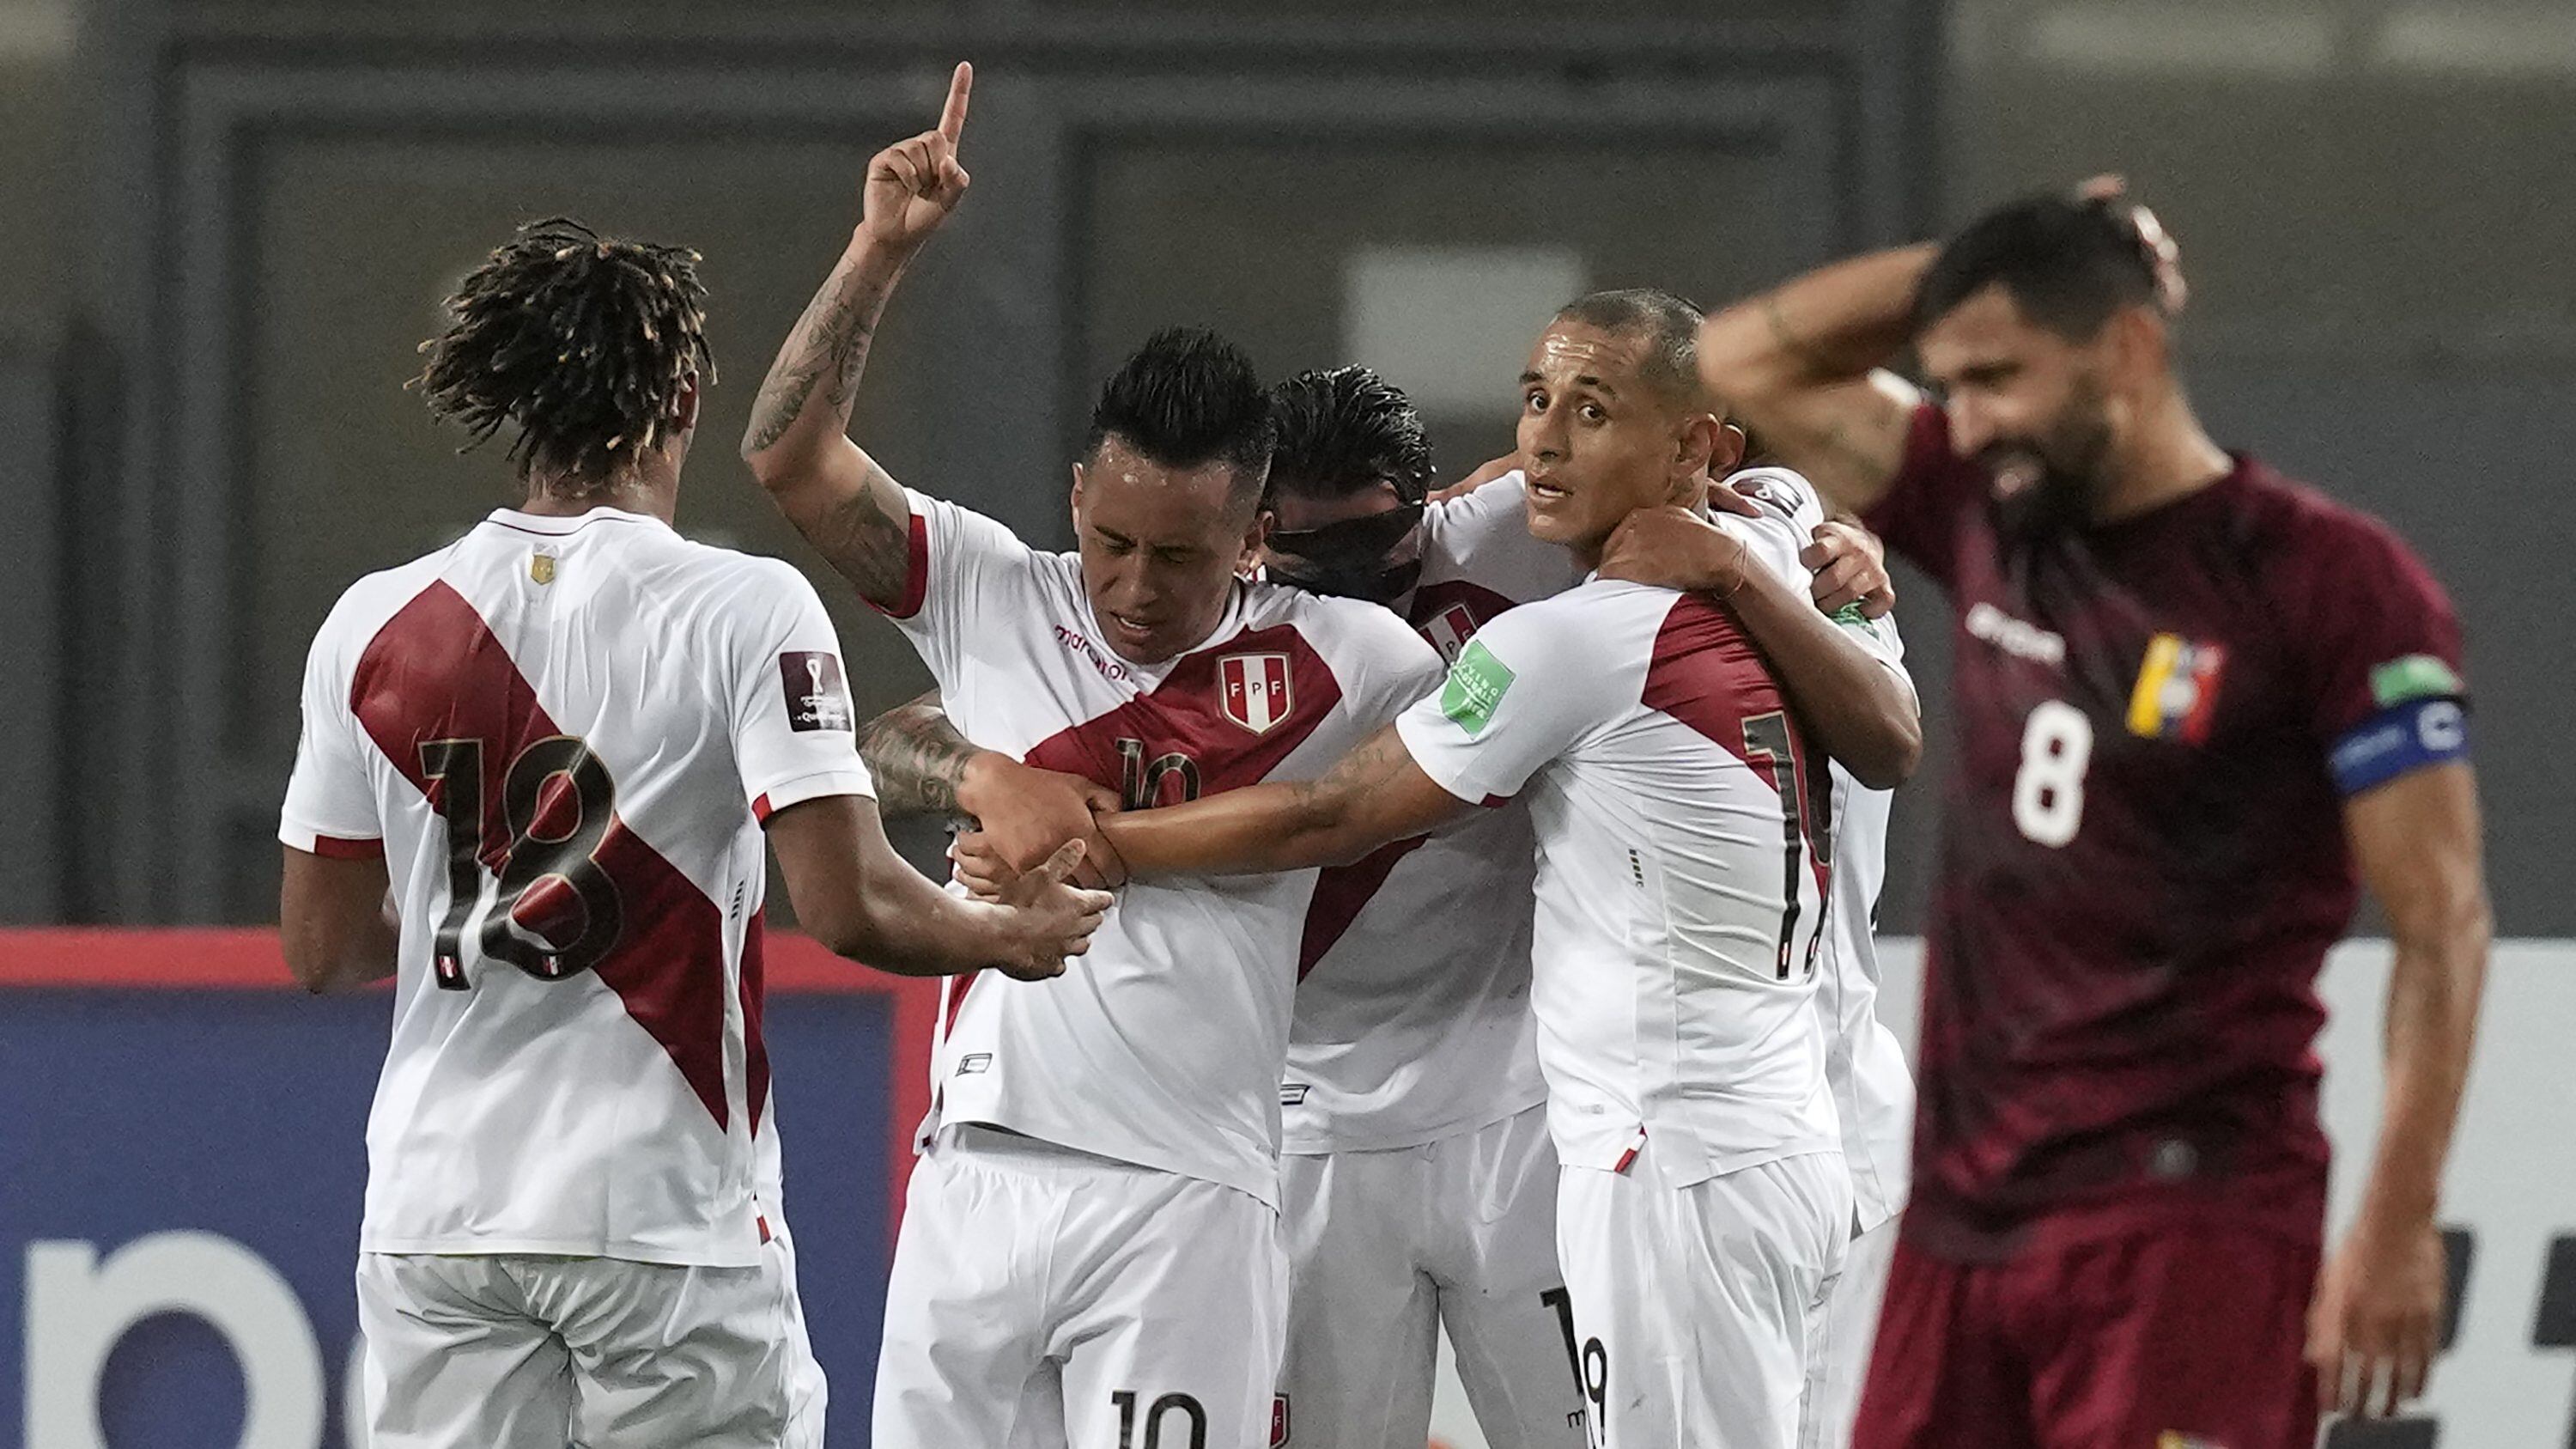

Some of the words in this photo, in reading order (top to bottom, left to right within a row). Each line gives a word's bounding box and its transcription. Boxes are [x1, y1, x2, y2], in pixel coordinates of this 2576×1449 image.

[418, 735, 621, 990] 18
[2013, 699, 2093, 848] 8
[24, 1228, 364, 1449] p
